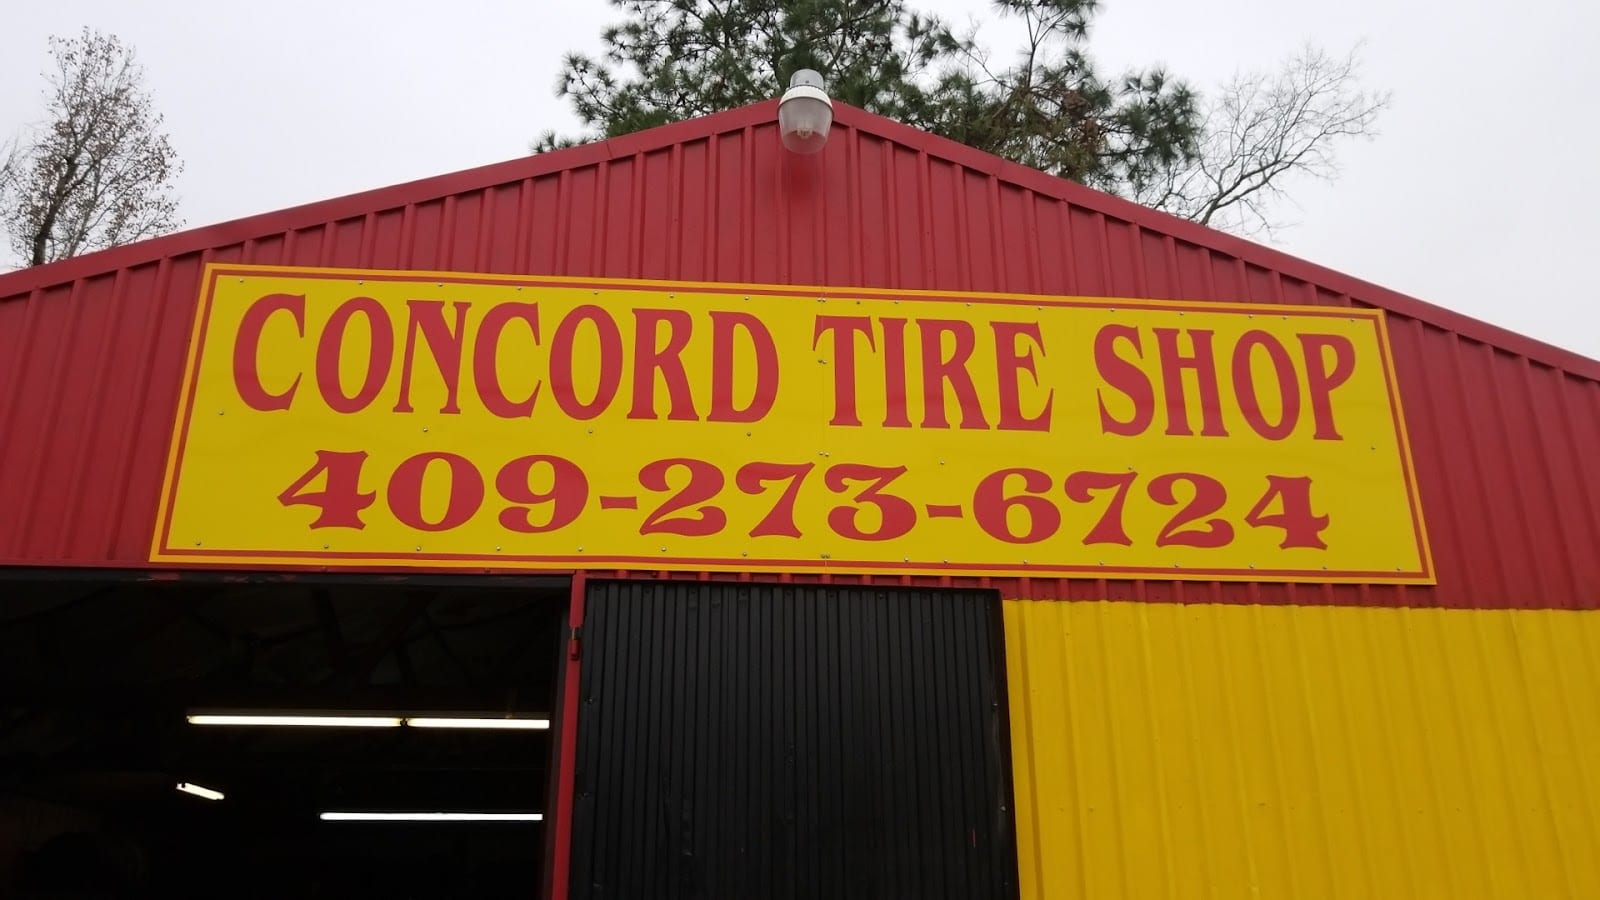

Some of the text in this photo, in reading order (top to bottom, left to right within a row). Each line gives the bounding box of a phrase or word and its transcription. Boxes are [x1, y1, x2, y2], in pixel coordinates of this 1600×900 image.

[233, 294, 1355, 441] CONCORD TIRE SHOP
[279, 451, 1329, 549] 409-273-6724
